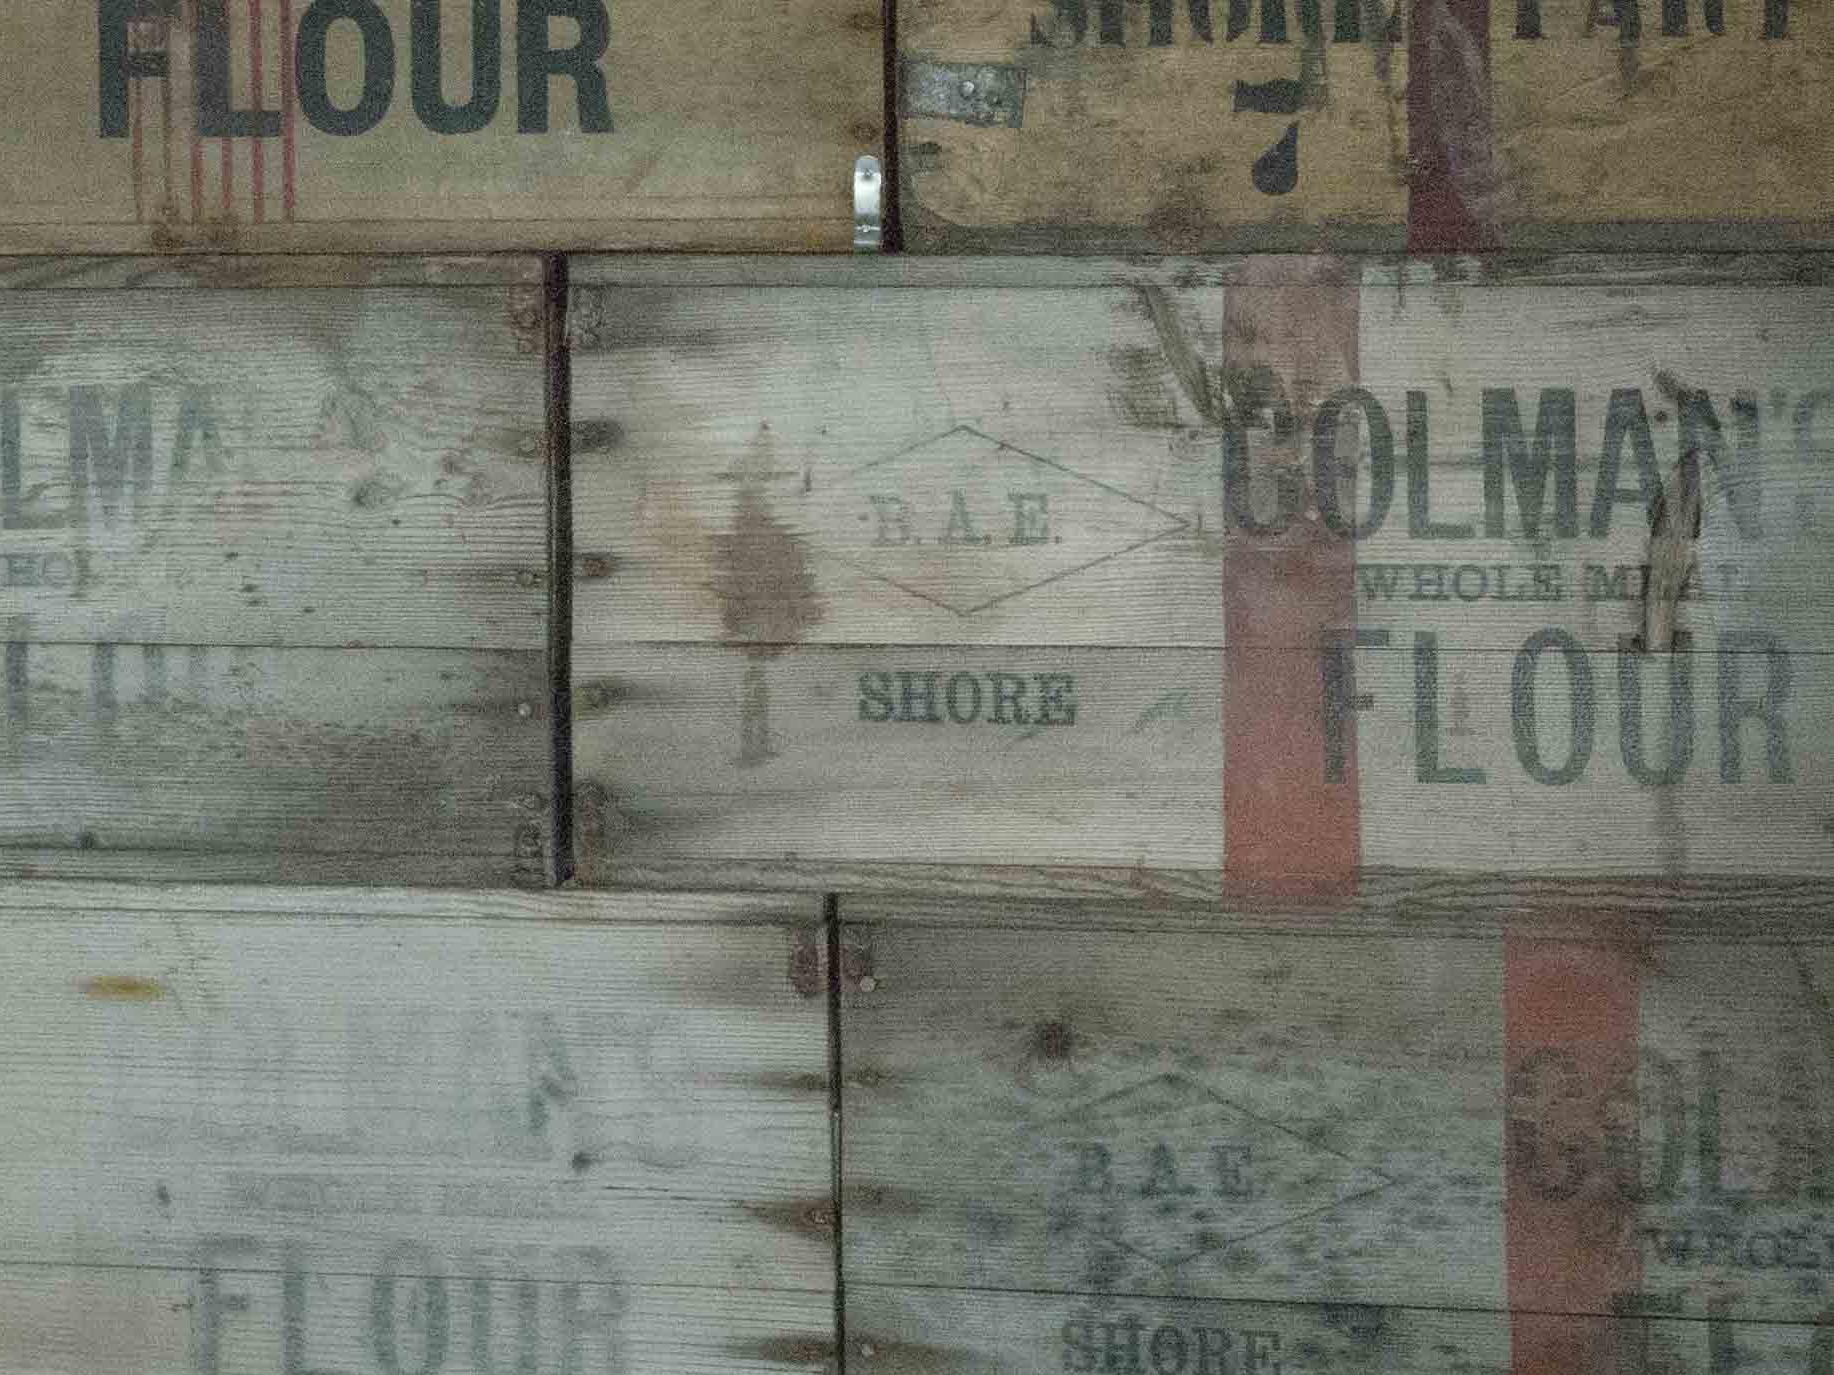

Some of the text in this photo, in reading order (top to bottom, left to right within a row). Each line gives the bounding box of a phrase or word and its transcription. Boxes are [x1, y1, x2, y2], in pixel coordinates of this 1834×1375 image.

[1356, 562, 1564, 602] WHOLE
[856, 669, 1078, 727] SHORE
[1316, 627, 1796, 786] FLOUR
[186, 1231, 636, 1375] FLOUR
[1060, 1316, 1284, 1375] SHORE
